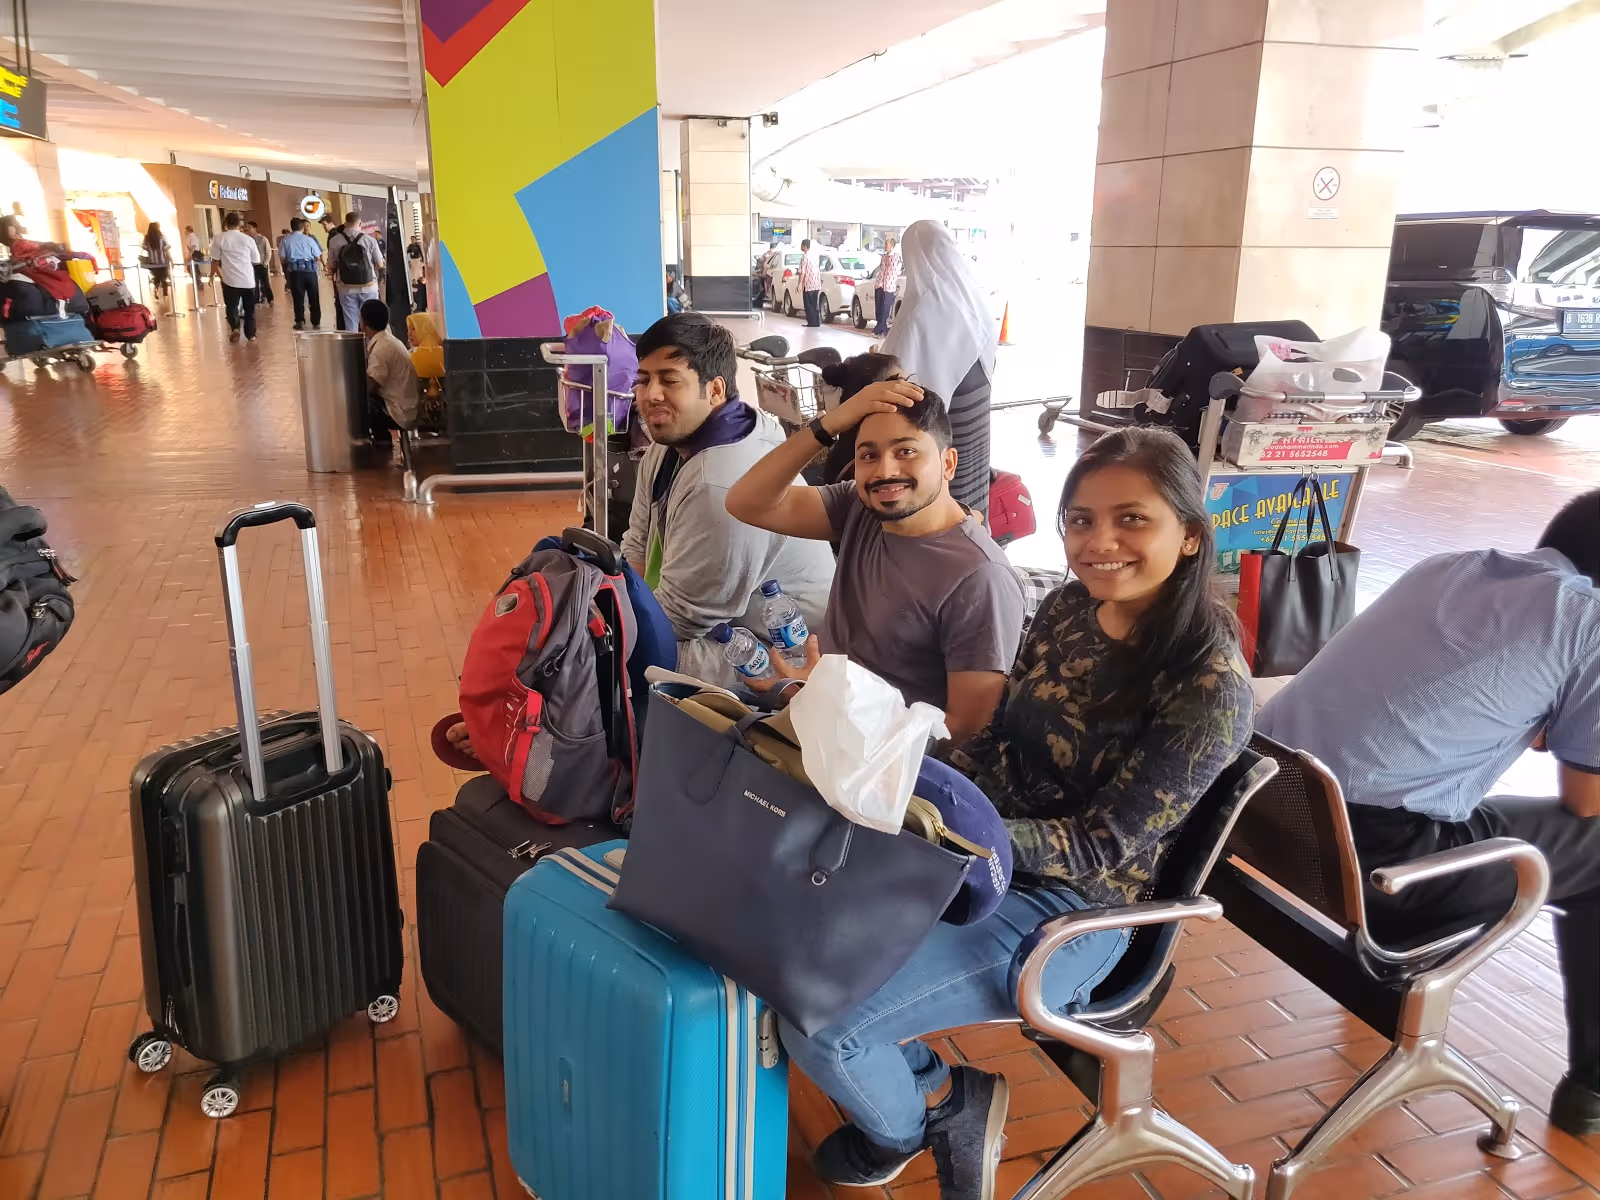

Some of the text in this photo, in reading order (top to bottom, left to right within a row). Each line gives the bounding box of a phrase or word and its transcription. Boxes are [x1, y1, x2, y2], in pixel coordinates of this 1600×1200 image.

[1211, 479, 1340, 529] PACE AVAILALE
[743, 789, 787, 818] MICHAEL KORS
